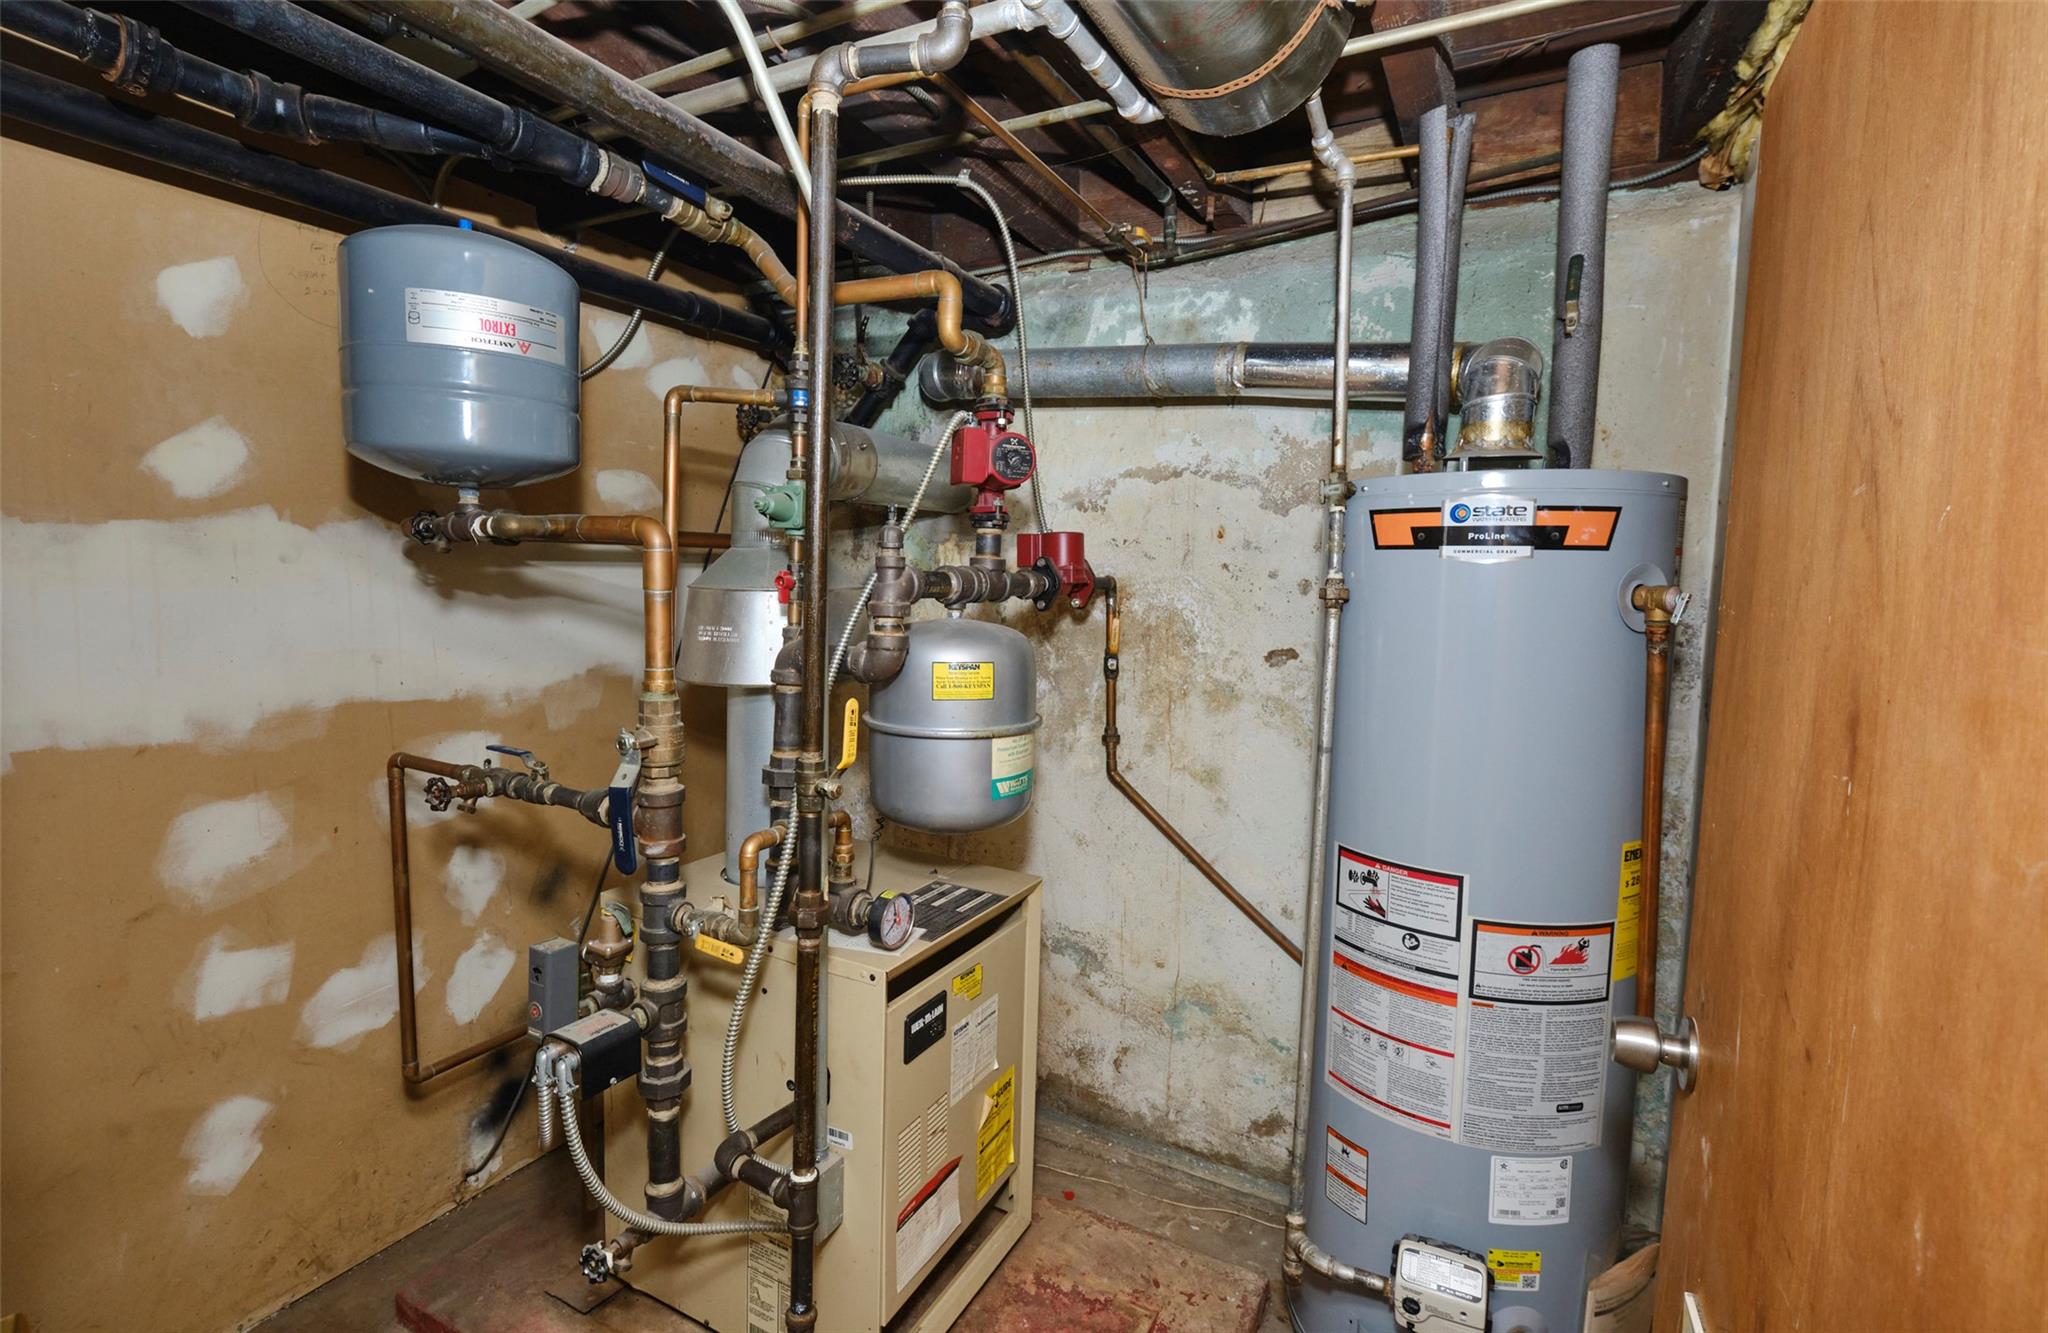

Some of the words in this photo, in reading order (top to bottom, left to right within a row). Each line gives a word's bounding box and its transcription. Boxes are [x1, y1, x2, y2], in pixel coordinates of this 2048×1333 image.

[480, 318, 517, 337] EXTROL
[1472, 505, 1528, 517] state
[1624, 848, 1642, 862] ENE
[1382, 865, 1409, 876] DANGER
